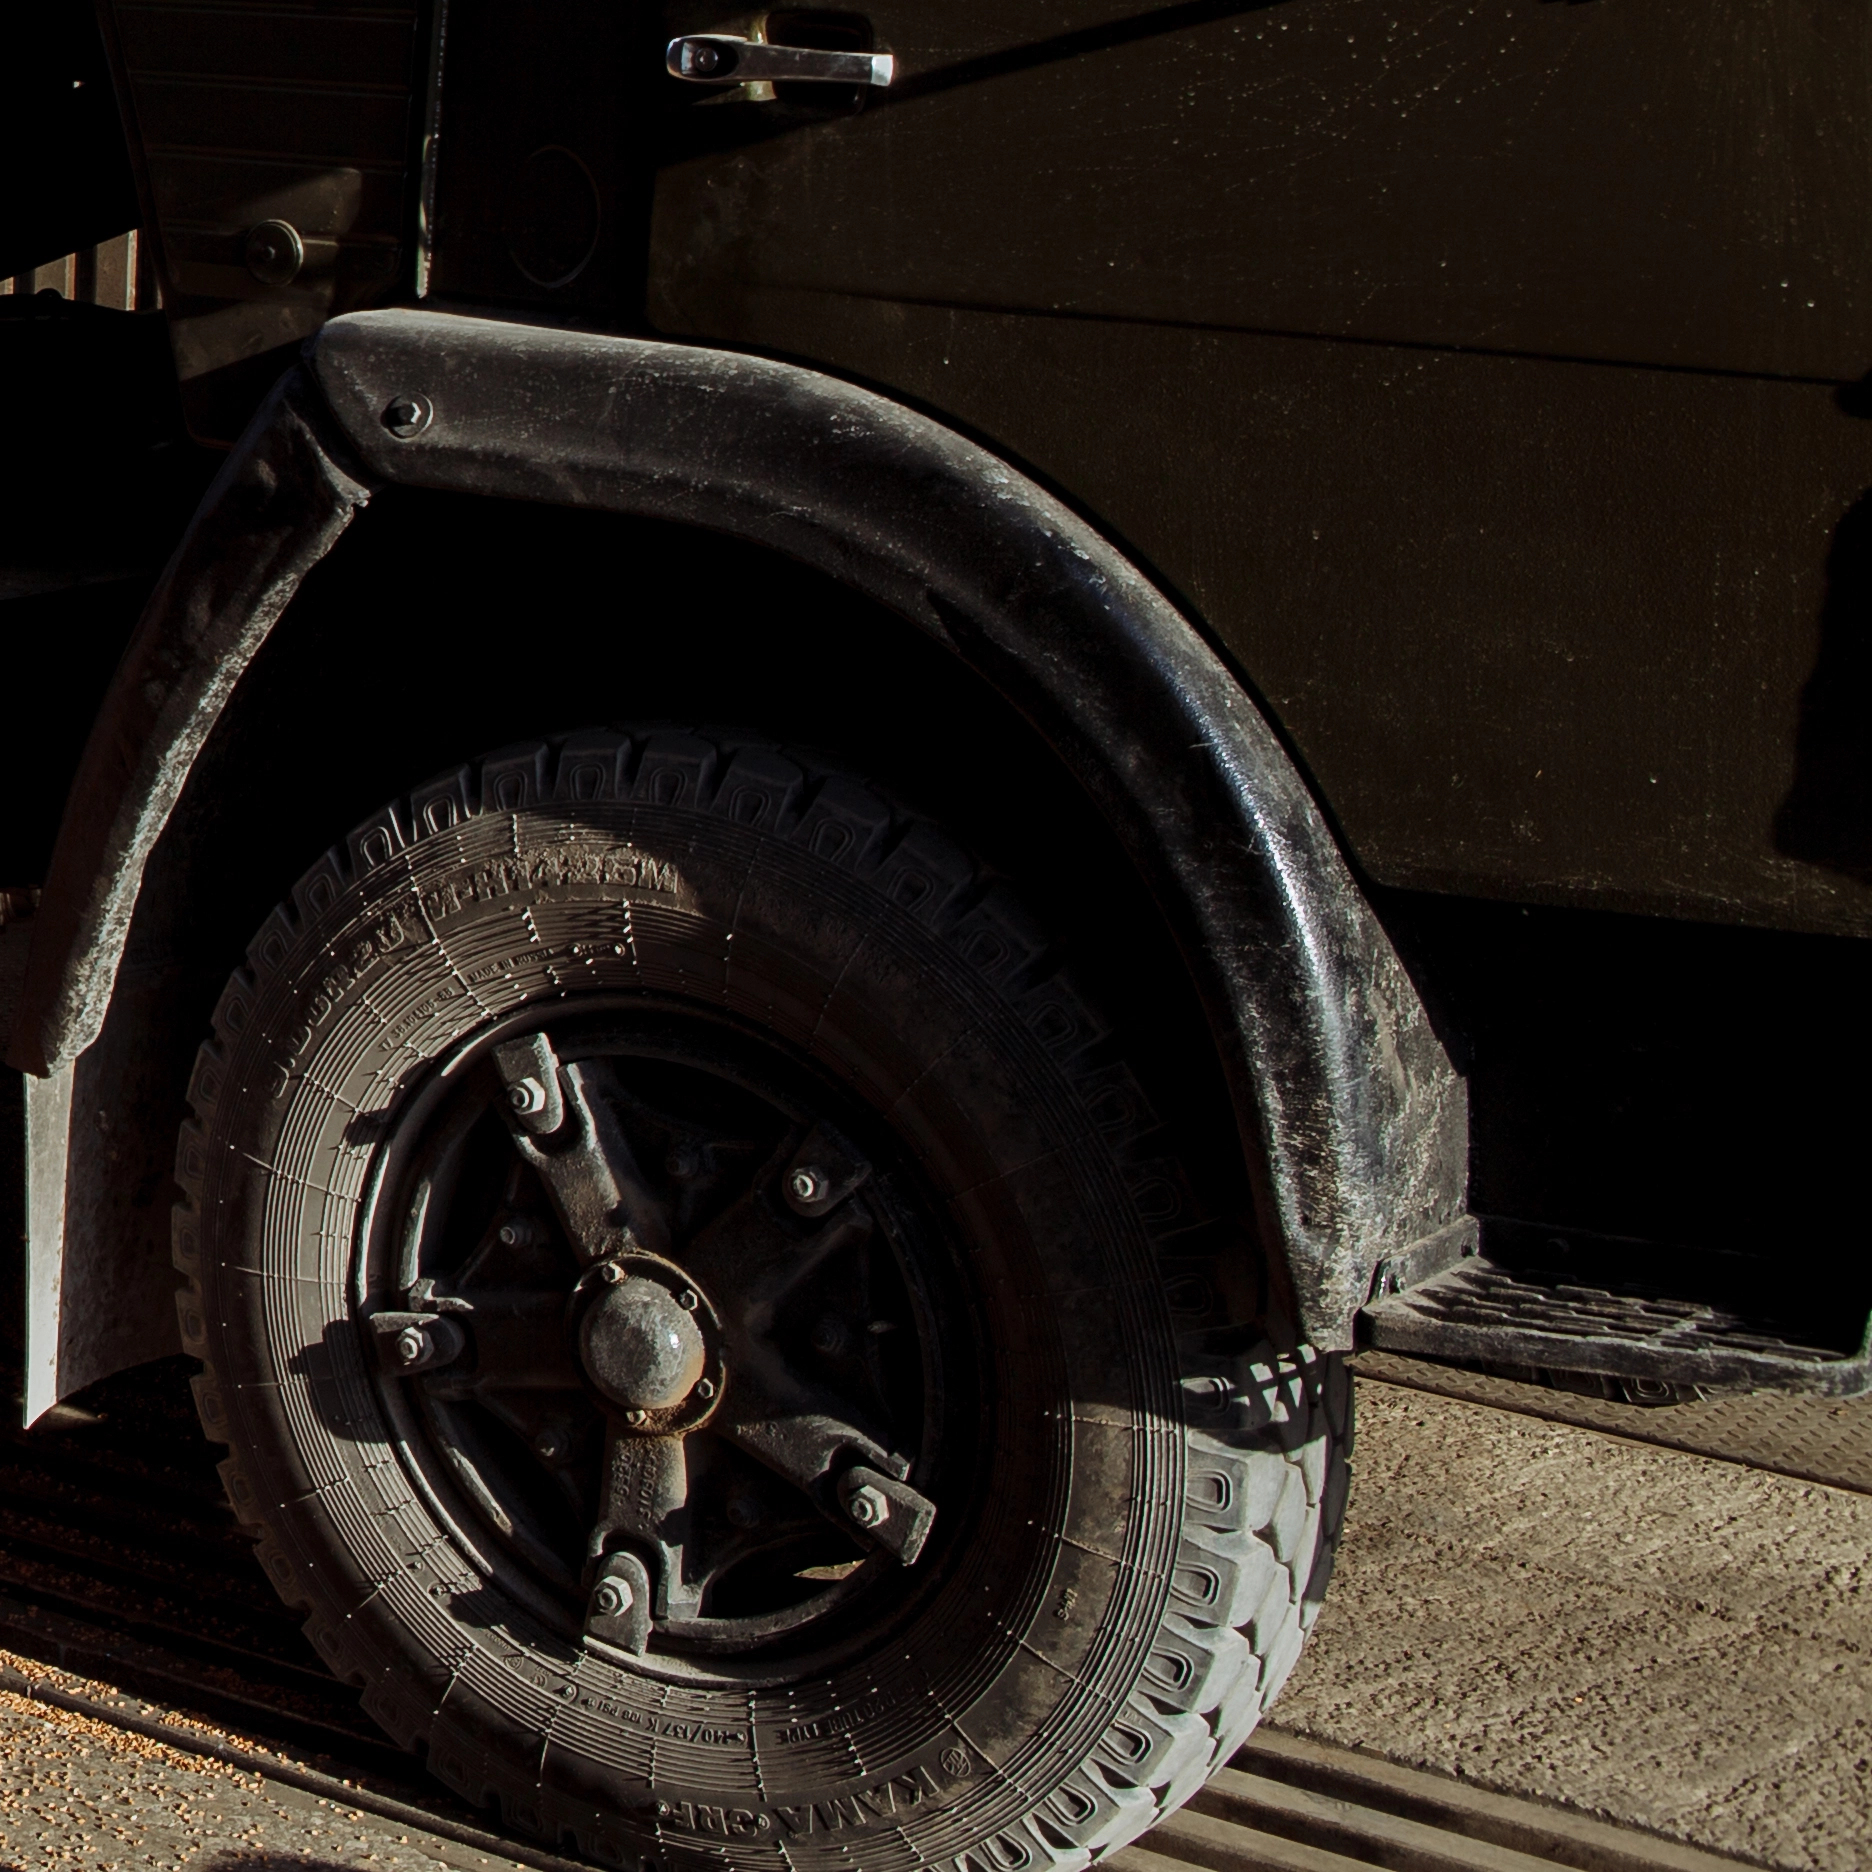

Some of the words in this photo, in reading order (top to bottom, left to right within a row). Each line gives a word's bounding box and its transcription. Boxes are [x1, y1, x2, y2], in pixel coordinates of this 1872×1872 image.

[466, 961, 500, 984] MADE
[512, 944, 555, 967] RUSSIA
[771, 1764, 941, 1838] KAMA
